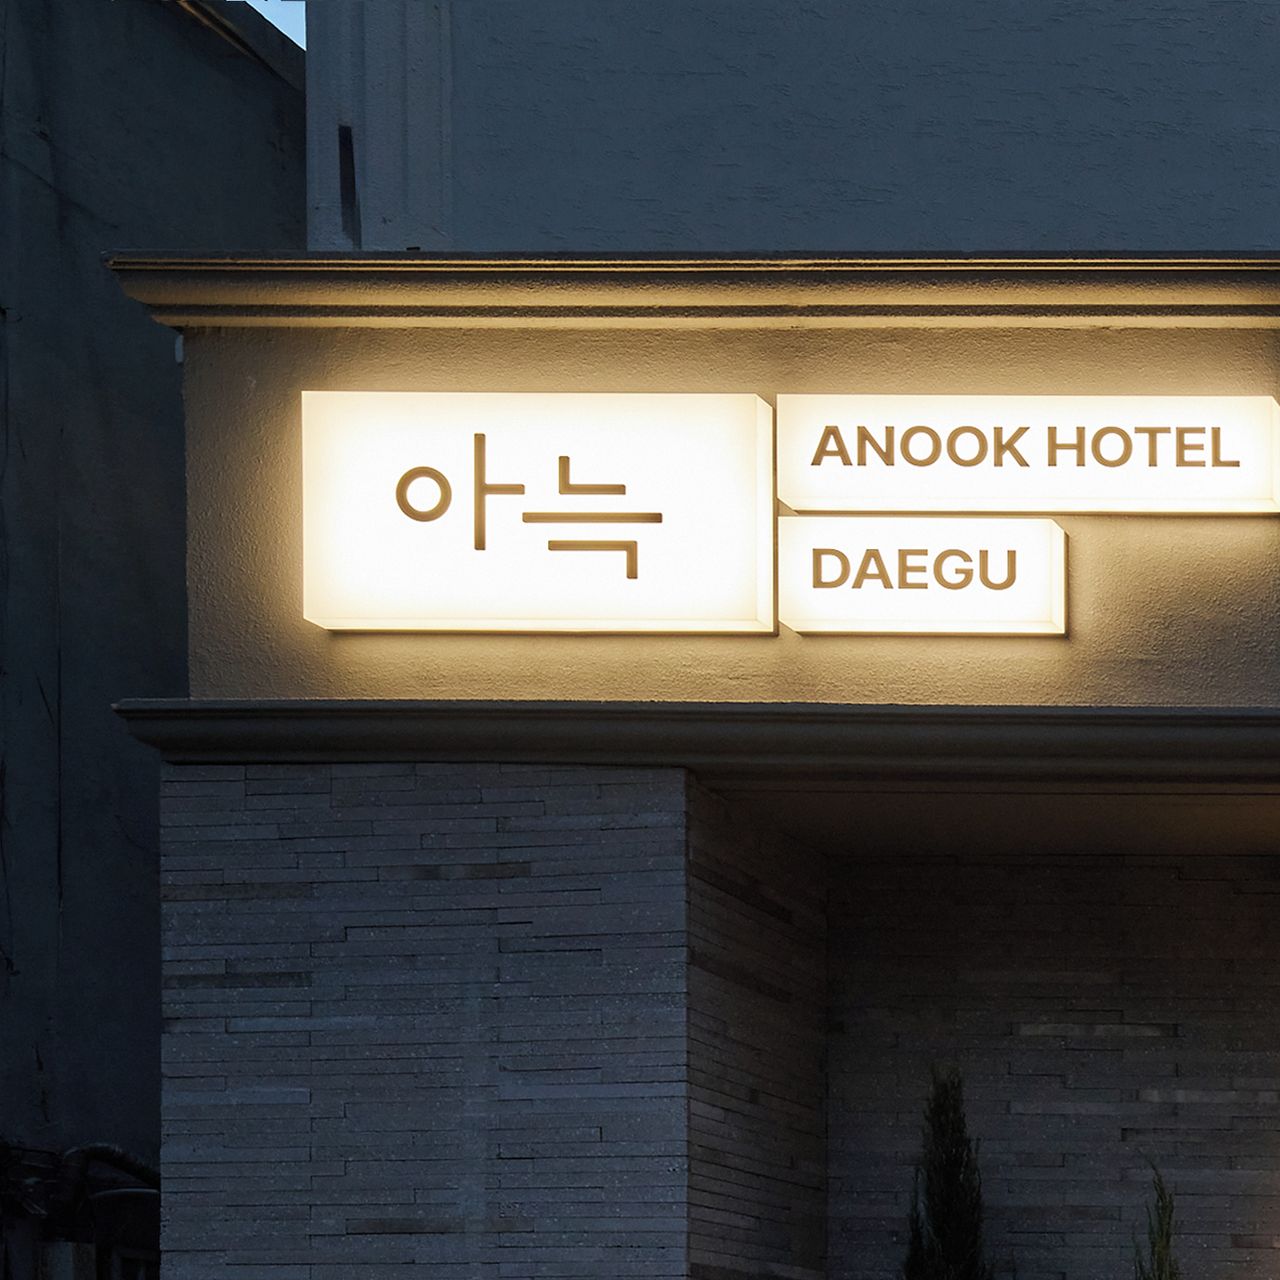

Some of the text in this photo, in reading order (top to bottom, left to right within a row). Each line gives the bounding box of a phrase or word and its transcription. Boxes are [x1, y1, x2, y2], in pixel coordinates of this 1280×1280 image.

[810, 425, 1241, 468] ANOOK HOTEL
[395, 432, 663, 580] 아늑
[812, 547, 1017, 591] DAEGU
